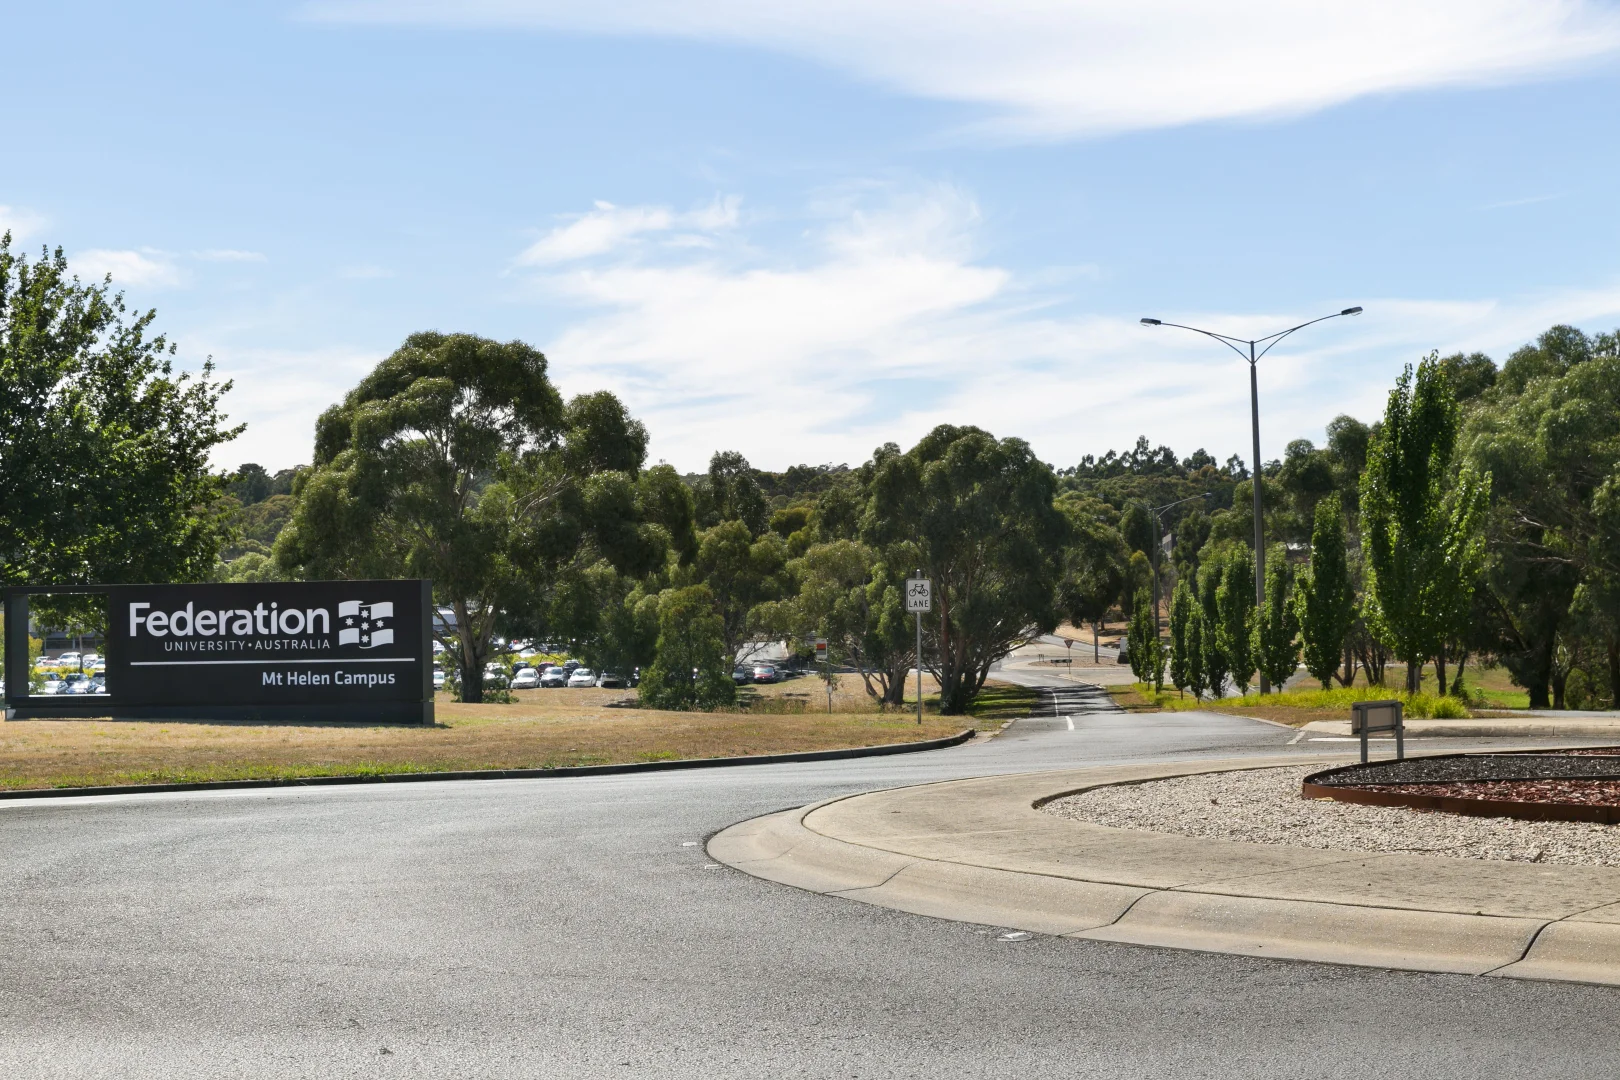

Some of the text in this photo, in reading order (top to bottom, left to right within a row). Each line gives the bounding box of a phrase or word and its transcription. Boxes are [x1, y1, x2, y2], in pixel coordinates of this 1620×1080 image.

[908, 600, 929, 608] LANE
[129, 601, 330, 637] Federation
[262, 670, 396, 689] Mt Helen Campus
